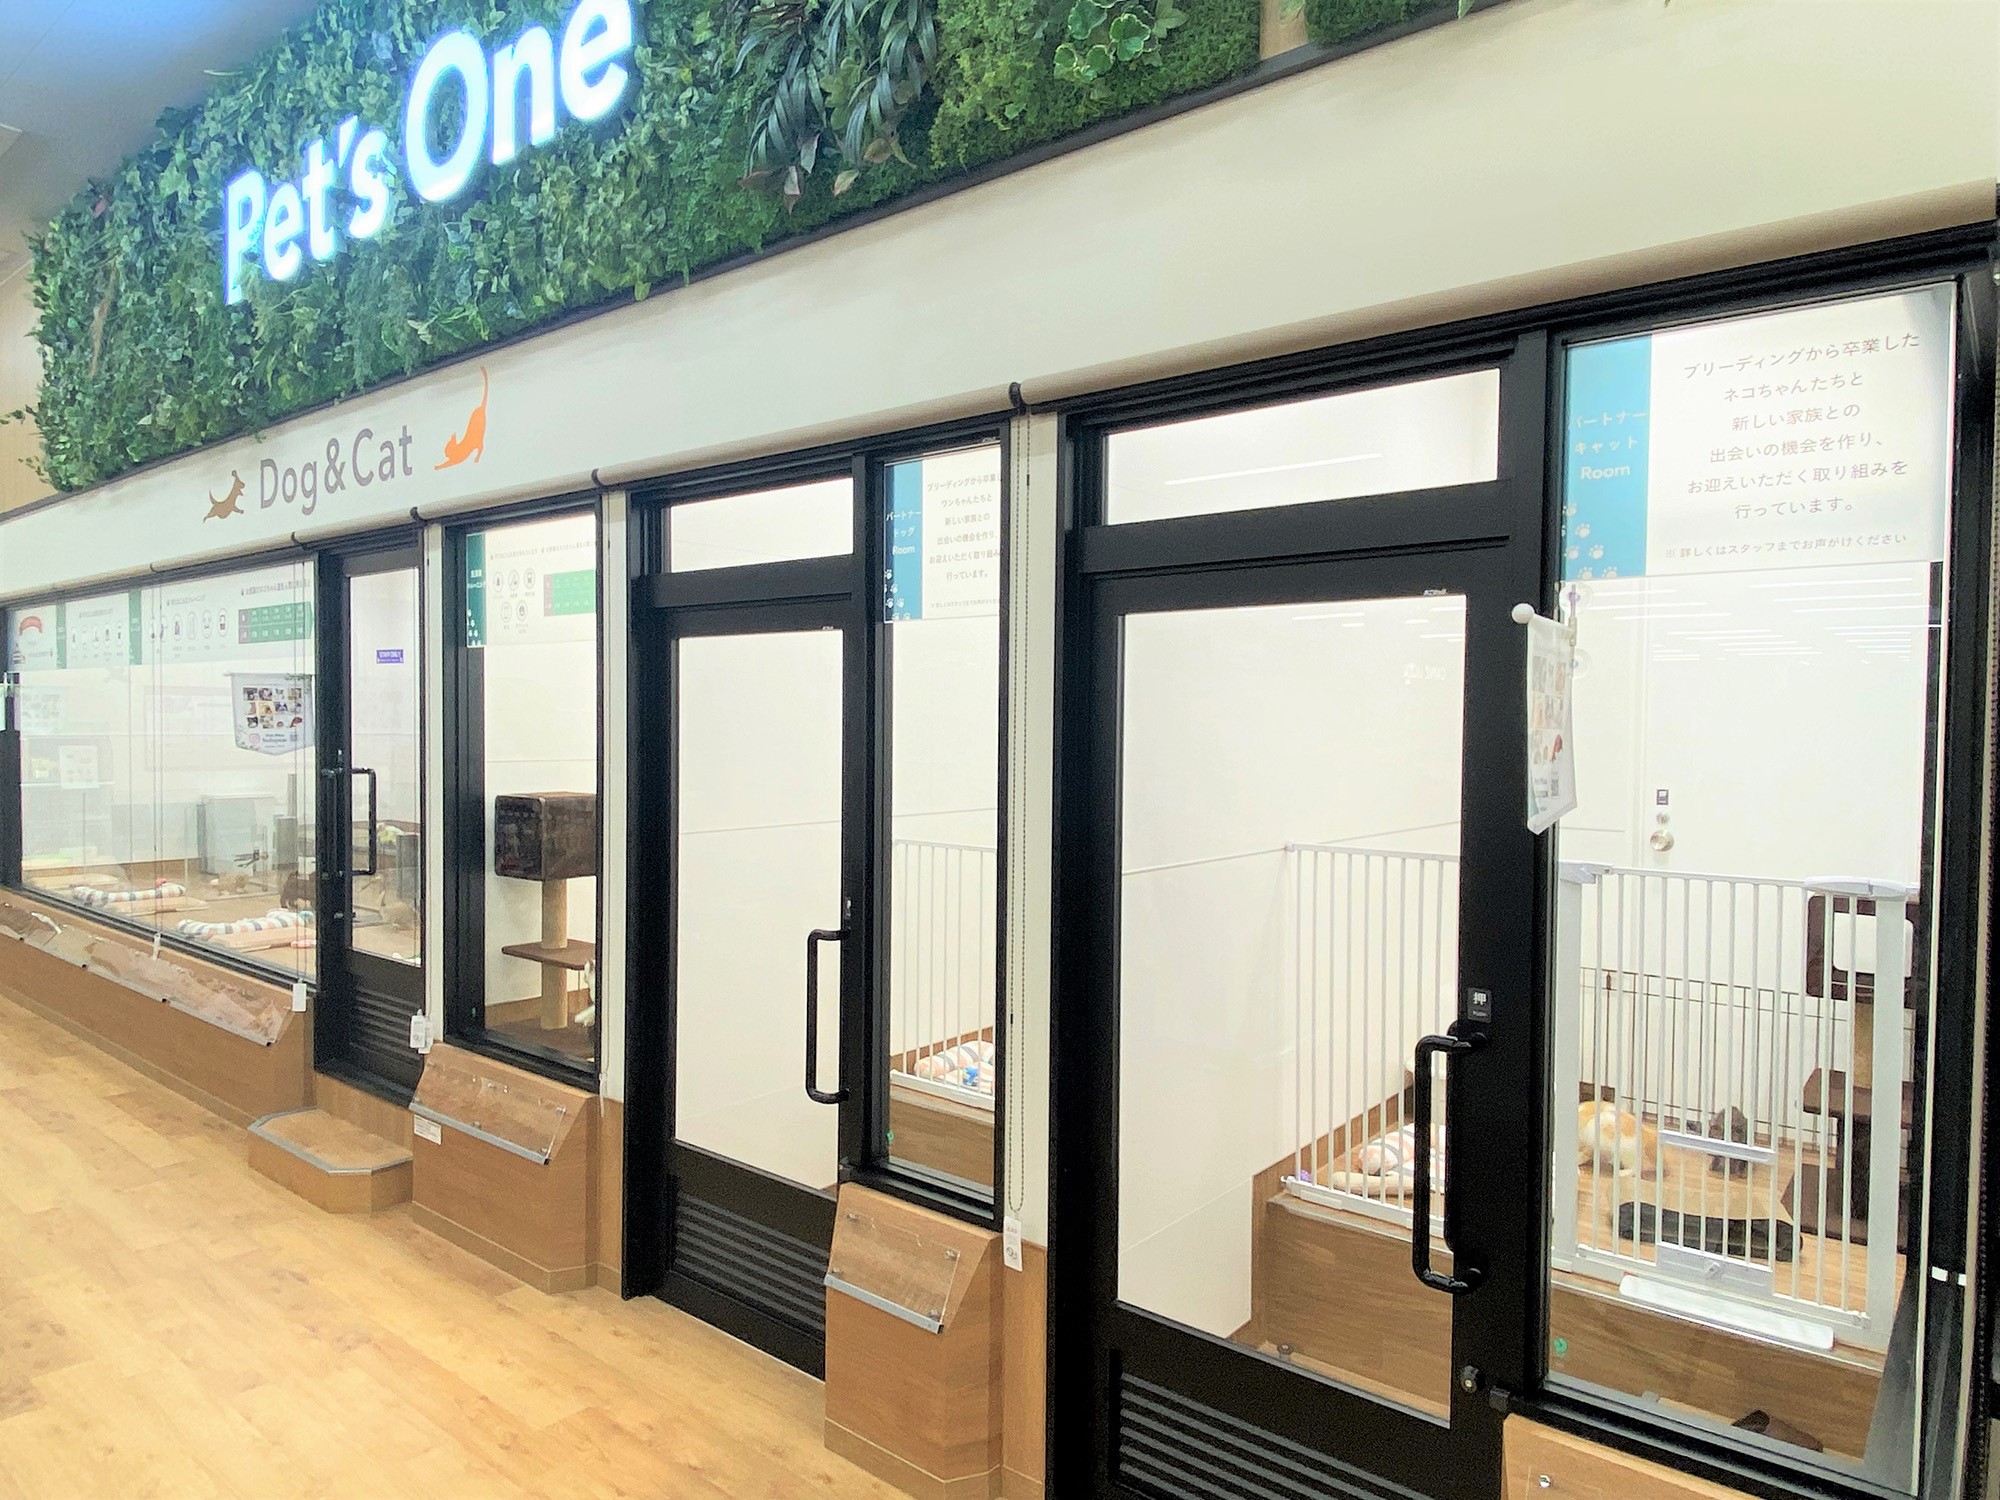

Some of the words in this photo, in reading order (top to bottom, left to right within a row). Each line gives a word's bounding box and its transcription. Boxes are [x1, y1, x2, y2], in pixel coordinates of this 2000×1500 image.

[224, 114, 390, 304] Pet's
[406, 0, 633, 203] One
[1684, 333, 1920, 379] ブリーディングから卒業した
[1723, 371, 1864, 402] ネコちゃんたちと
[1732, 403, 1861, 432] 新しい家族との
[1574, 434, 1639, 456] キャット
[1709, 431, 1883, 464] 出会いの機会を作り、
[259, 425, 413, 516] Dog&Cat
[1580, 465, 1631, 481] Room
[1688, 459, 1909, 494] お迎えいただく取り組みを
[886, 510, 921, 521] パートナー
[1734, 496, 1854, 520] 行っています。
[892, 545, 915, 556] Room
[1473, 991, 1487, 1006] 押
